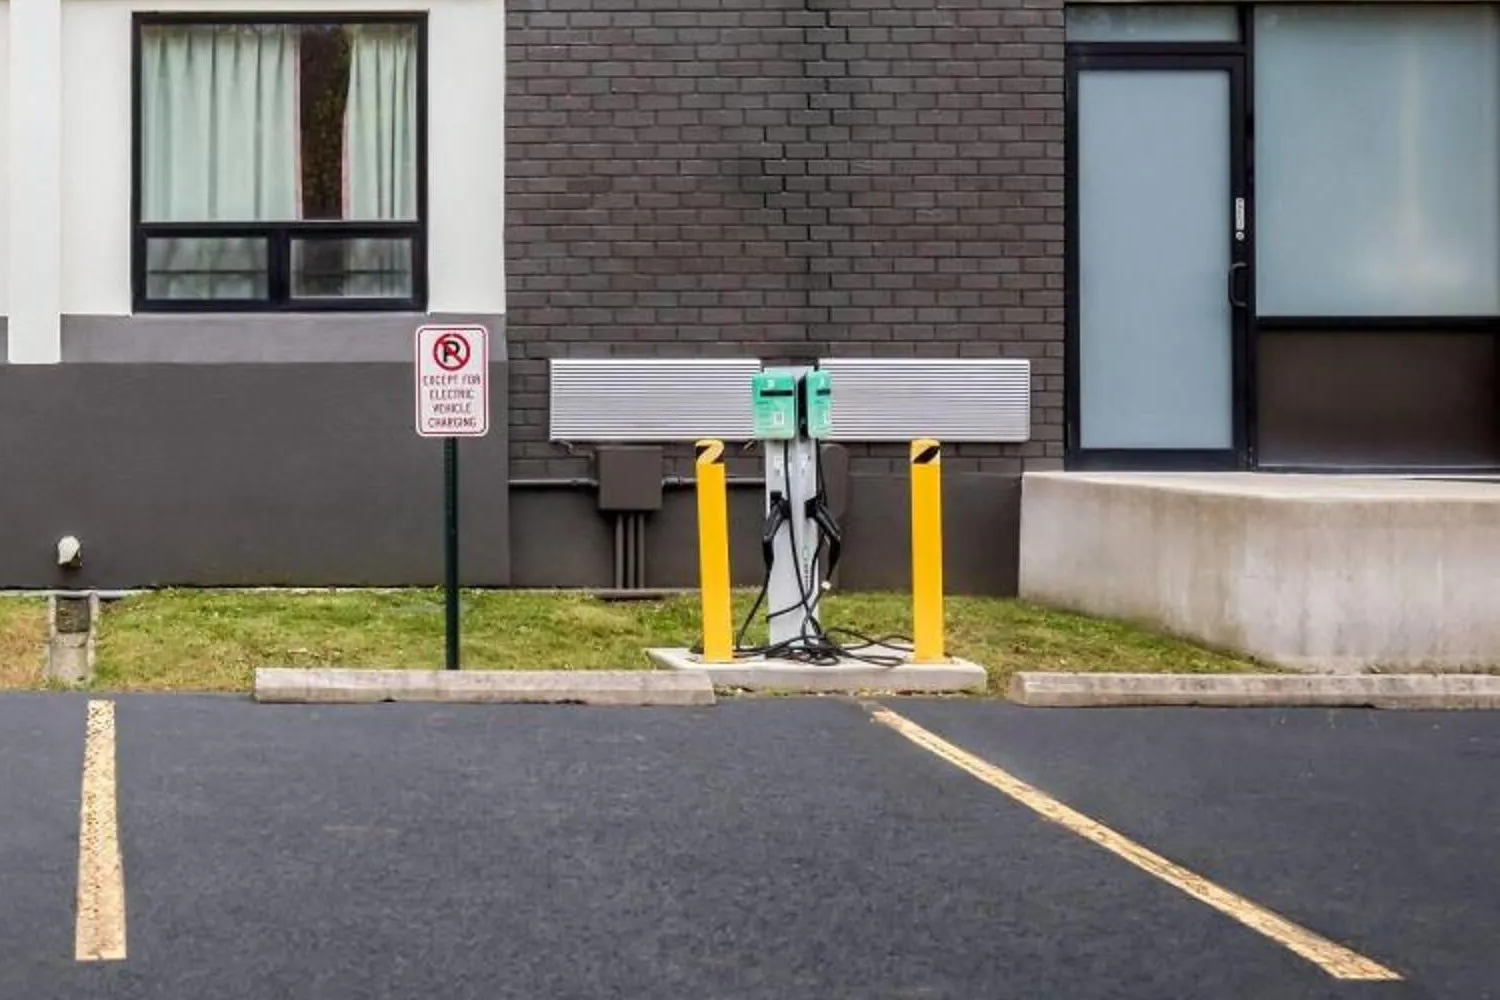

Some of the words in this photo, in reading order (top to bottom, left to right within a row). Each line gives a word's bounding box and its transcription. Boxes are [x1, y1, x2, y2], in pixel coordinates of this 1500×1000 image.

[423, 375, 459, 386] EXCEPT
[462, 375, 481, 385] FOR
[429, 389, 475, 400] ELECTRIC
[432, 403, 471, 414] VEHICLE
[428, 417, 477, 428] CHARGING
